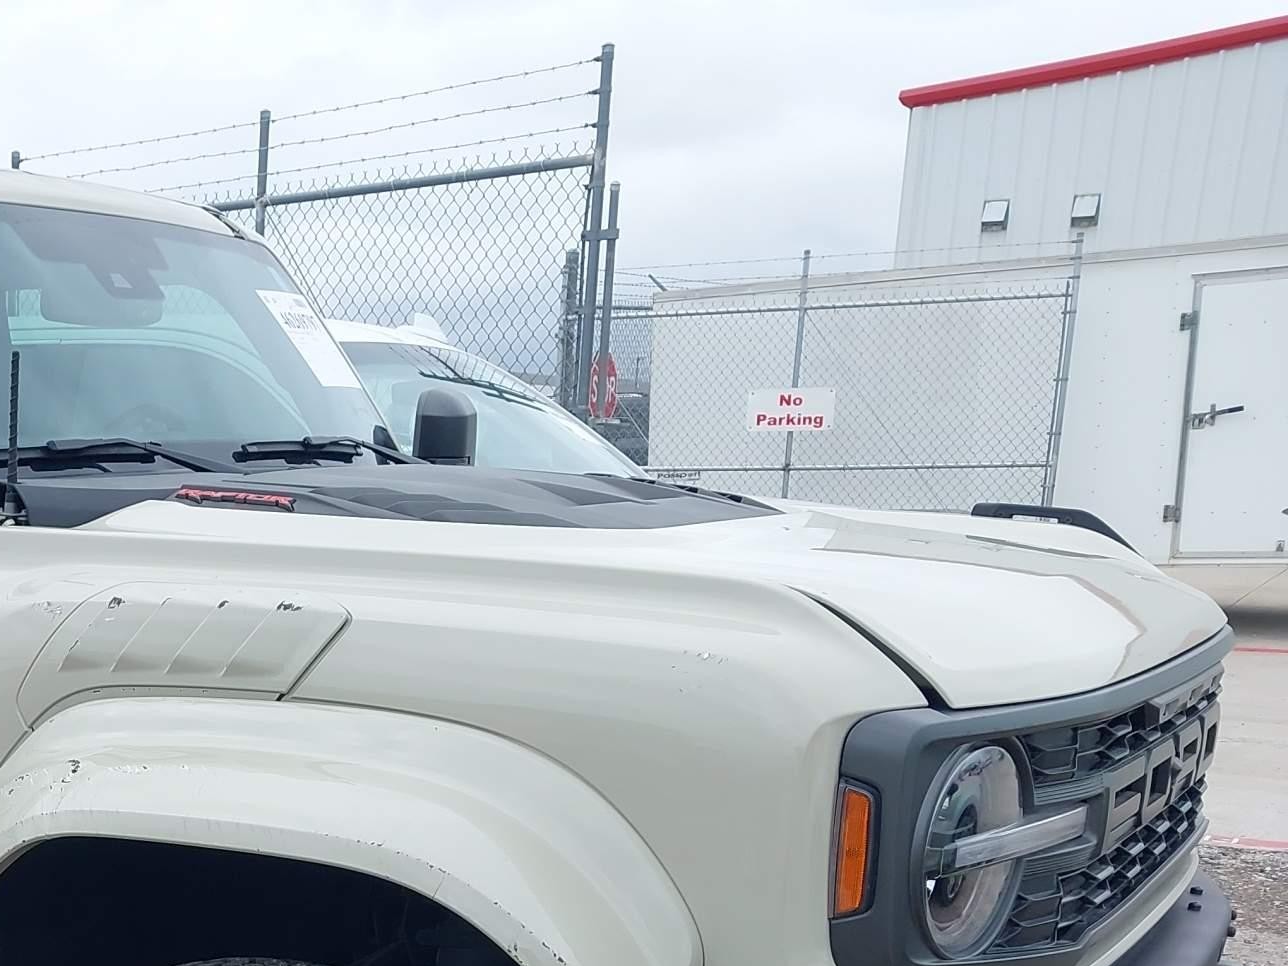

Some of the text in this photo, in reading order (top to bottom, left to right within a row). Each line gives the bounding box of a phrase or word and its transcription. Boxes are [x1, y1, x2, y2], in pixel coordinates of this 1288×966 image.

[592, 374, 616, 403] SP
[779, 394, 803, 406] No
[756, 413, 824, 428] Parking
[175, 487, 296, 512] RAPTOR
